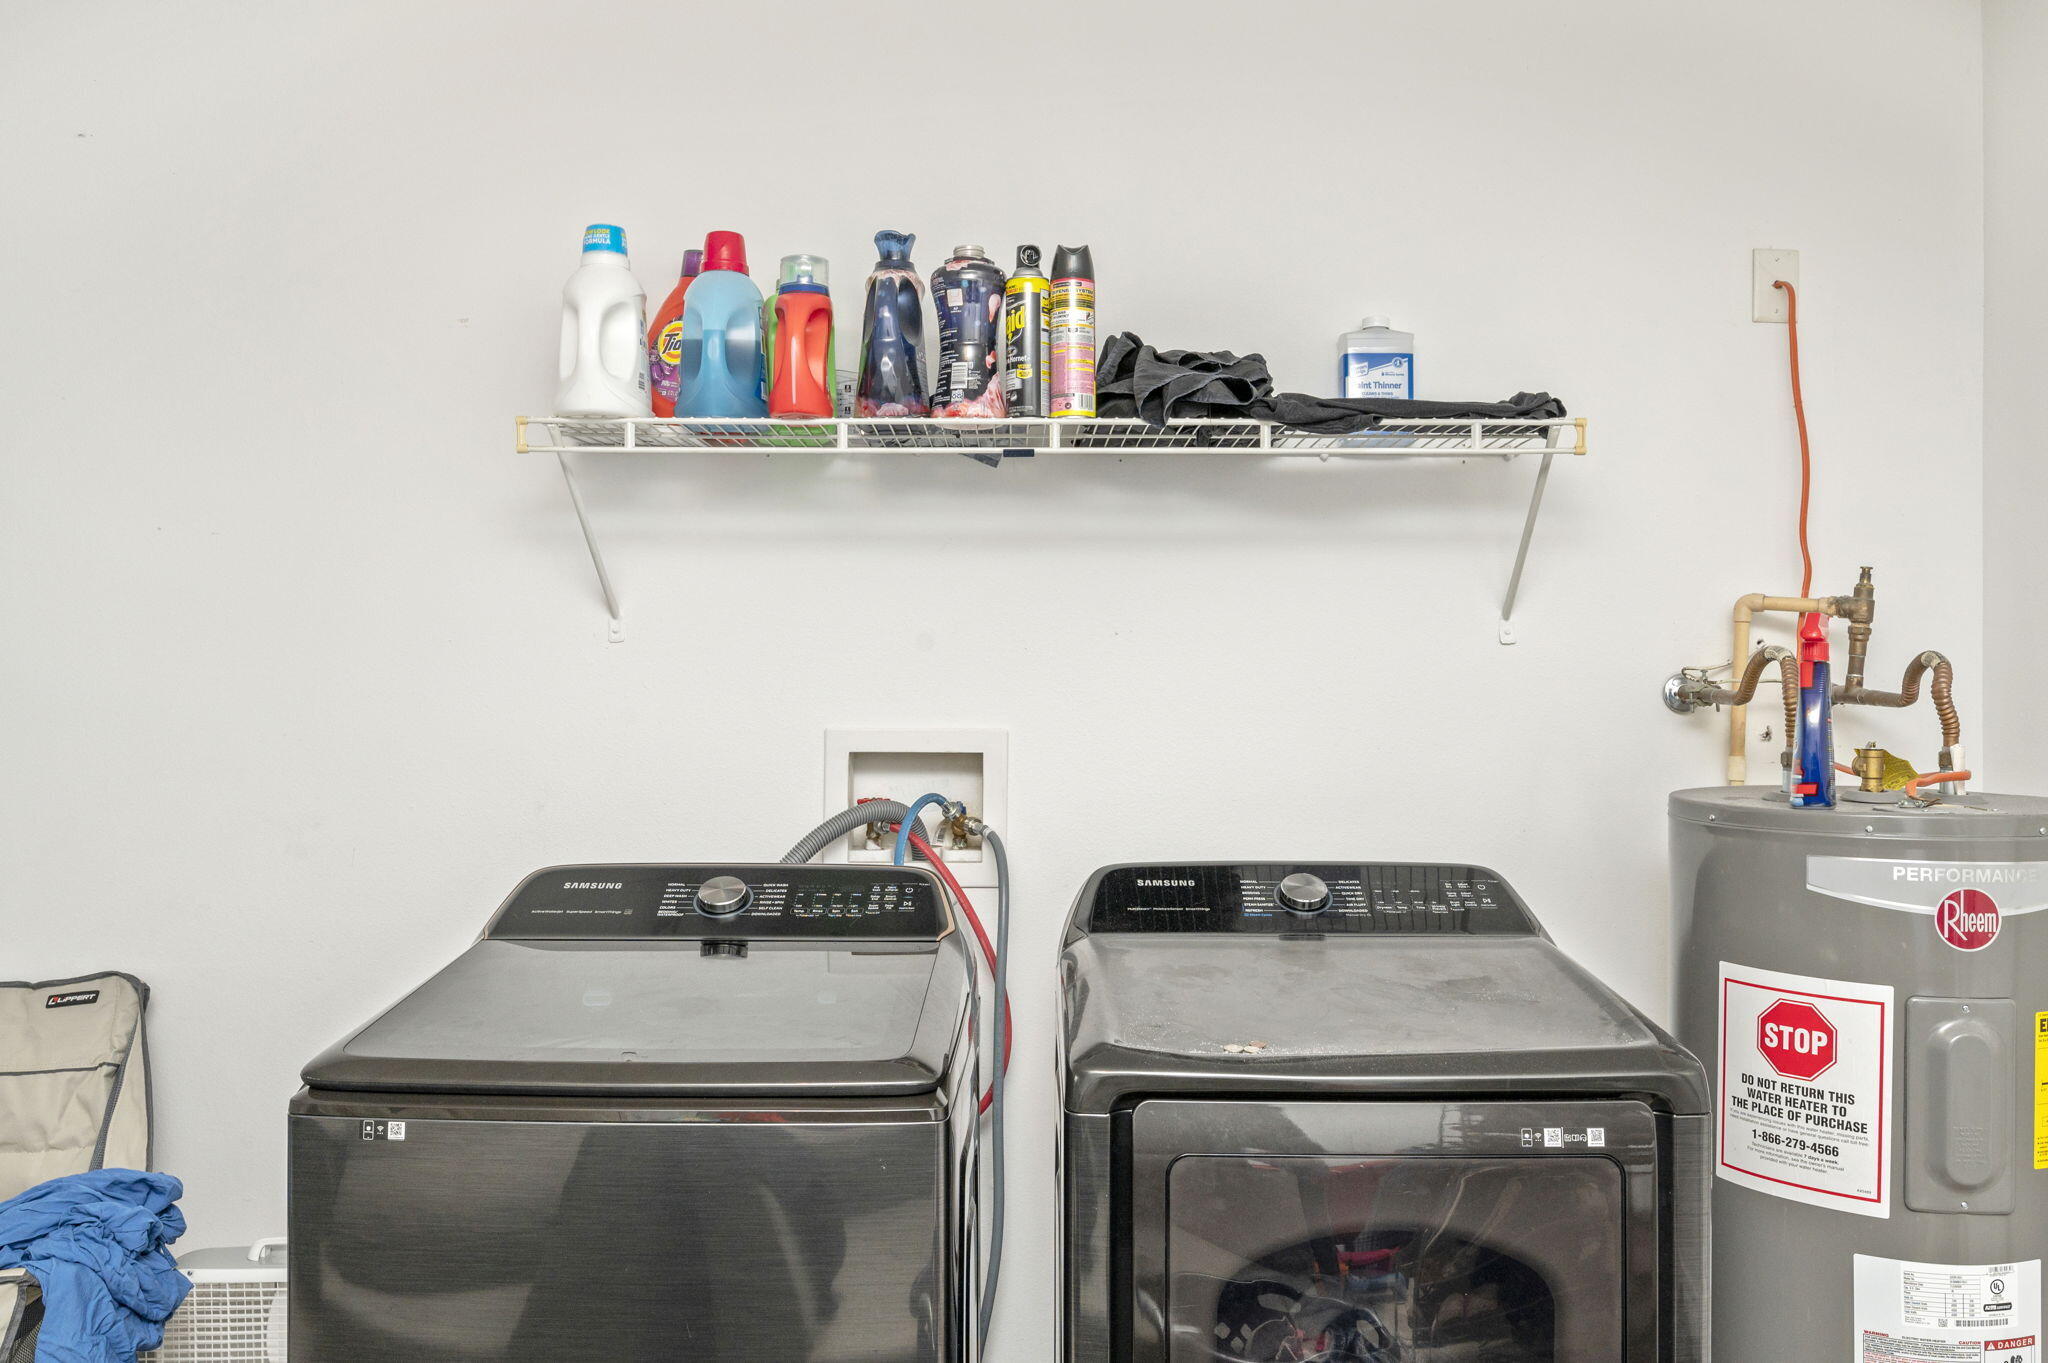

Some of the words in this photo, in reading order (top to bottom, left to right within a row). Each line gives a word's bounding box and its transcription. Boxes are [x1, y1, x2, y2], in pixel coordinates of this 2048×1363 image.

[1006, 306, 1025, 335] aid
[1373, 381, 1402, 389] Thinner
[1137, 879, 1196, 887] SAMSUNG
[1943, 890, 1997, 941] Rheem
[1764, 1022, 1829, 1056] STOP
[1741, 1073, 1754, 1085] DO
[1757, 1077, 1777, 1091] NOT
[1780, 1082, 1825, 1100] RETURN
[1828, 1091, 1855, 1105] THIS
[1747, 1087, 1782, 1105] WATER
[1785, 1096, 1828, 1114] HEATER
[1832, 1105, 1847, 1117] TO
[1731, 1095, 1748, 1110] THE
[1751, 1101, 1784, 1119] PLACE
[1787, 1109, 1802, 1122] OF
[1805, 1113, 1868, 1134] PURCHASE
[1752, 1129, 1839, 1157] 1-866-279-4566
[1993, 1282, 2002, 1292] UL
[1997, 1337, 2033, 1349] DANGER
